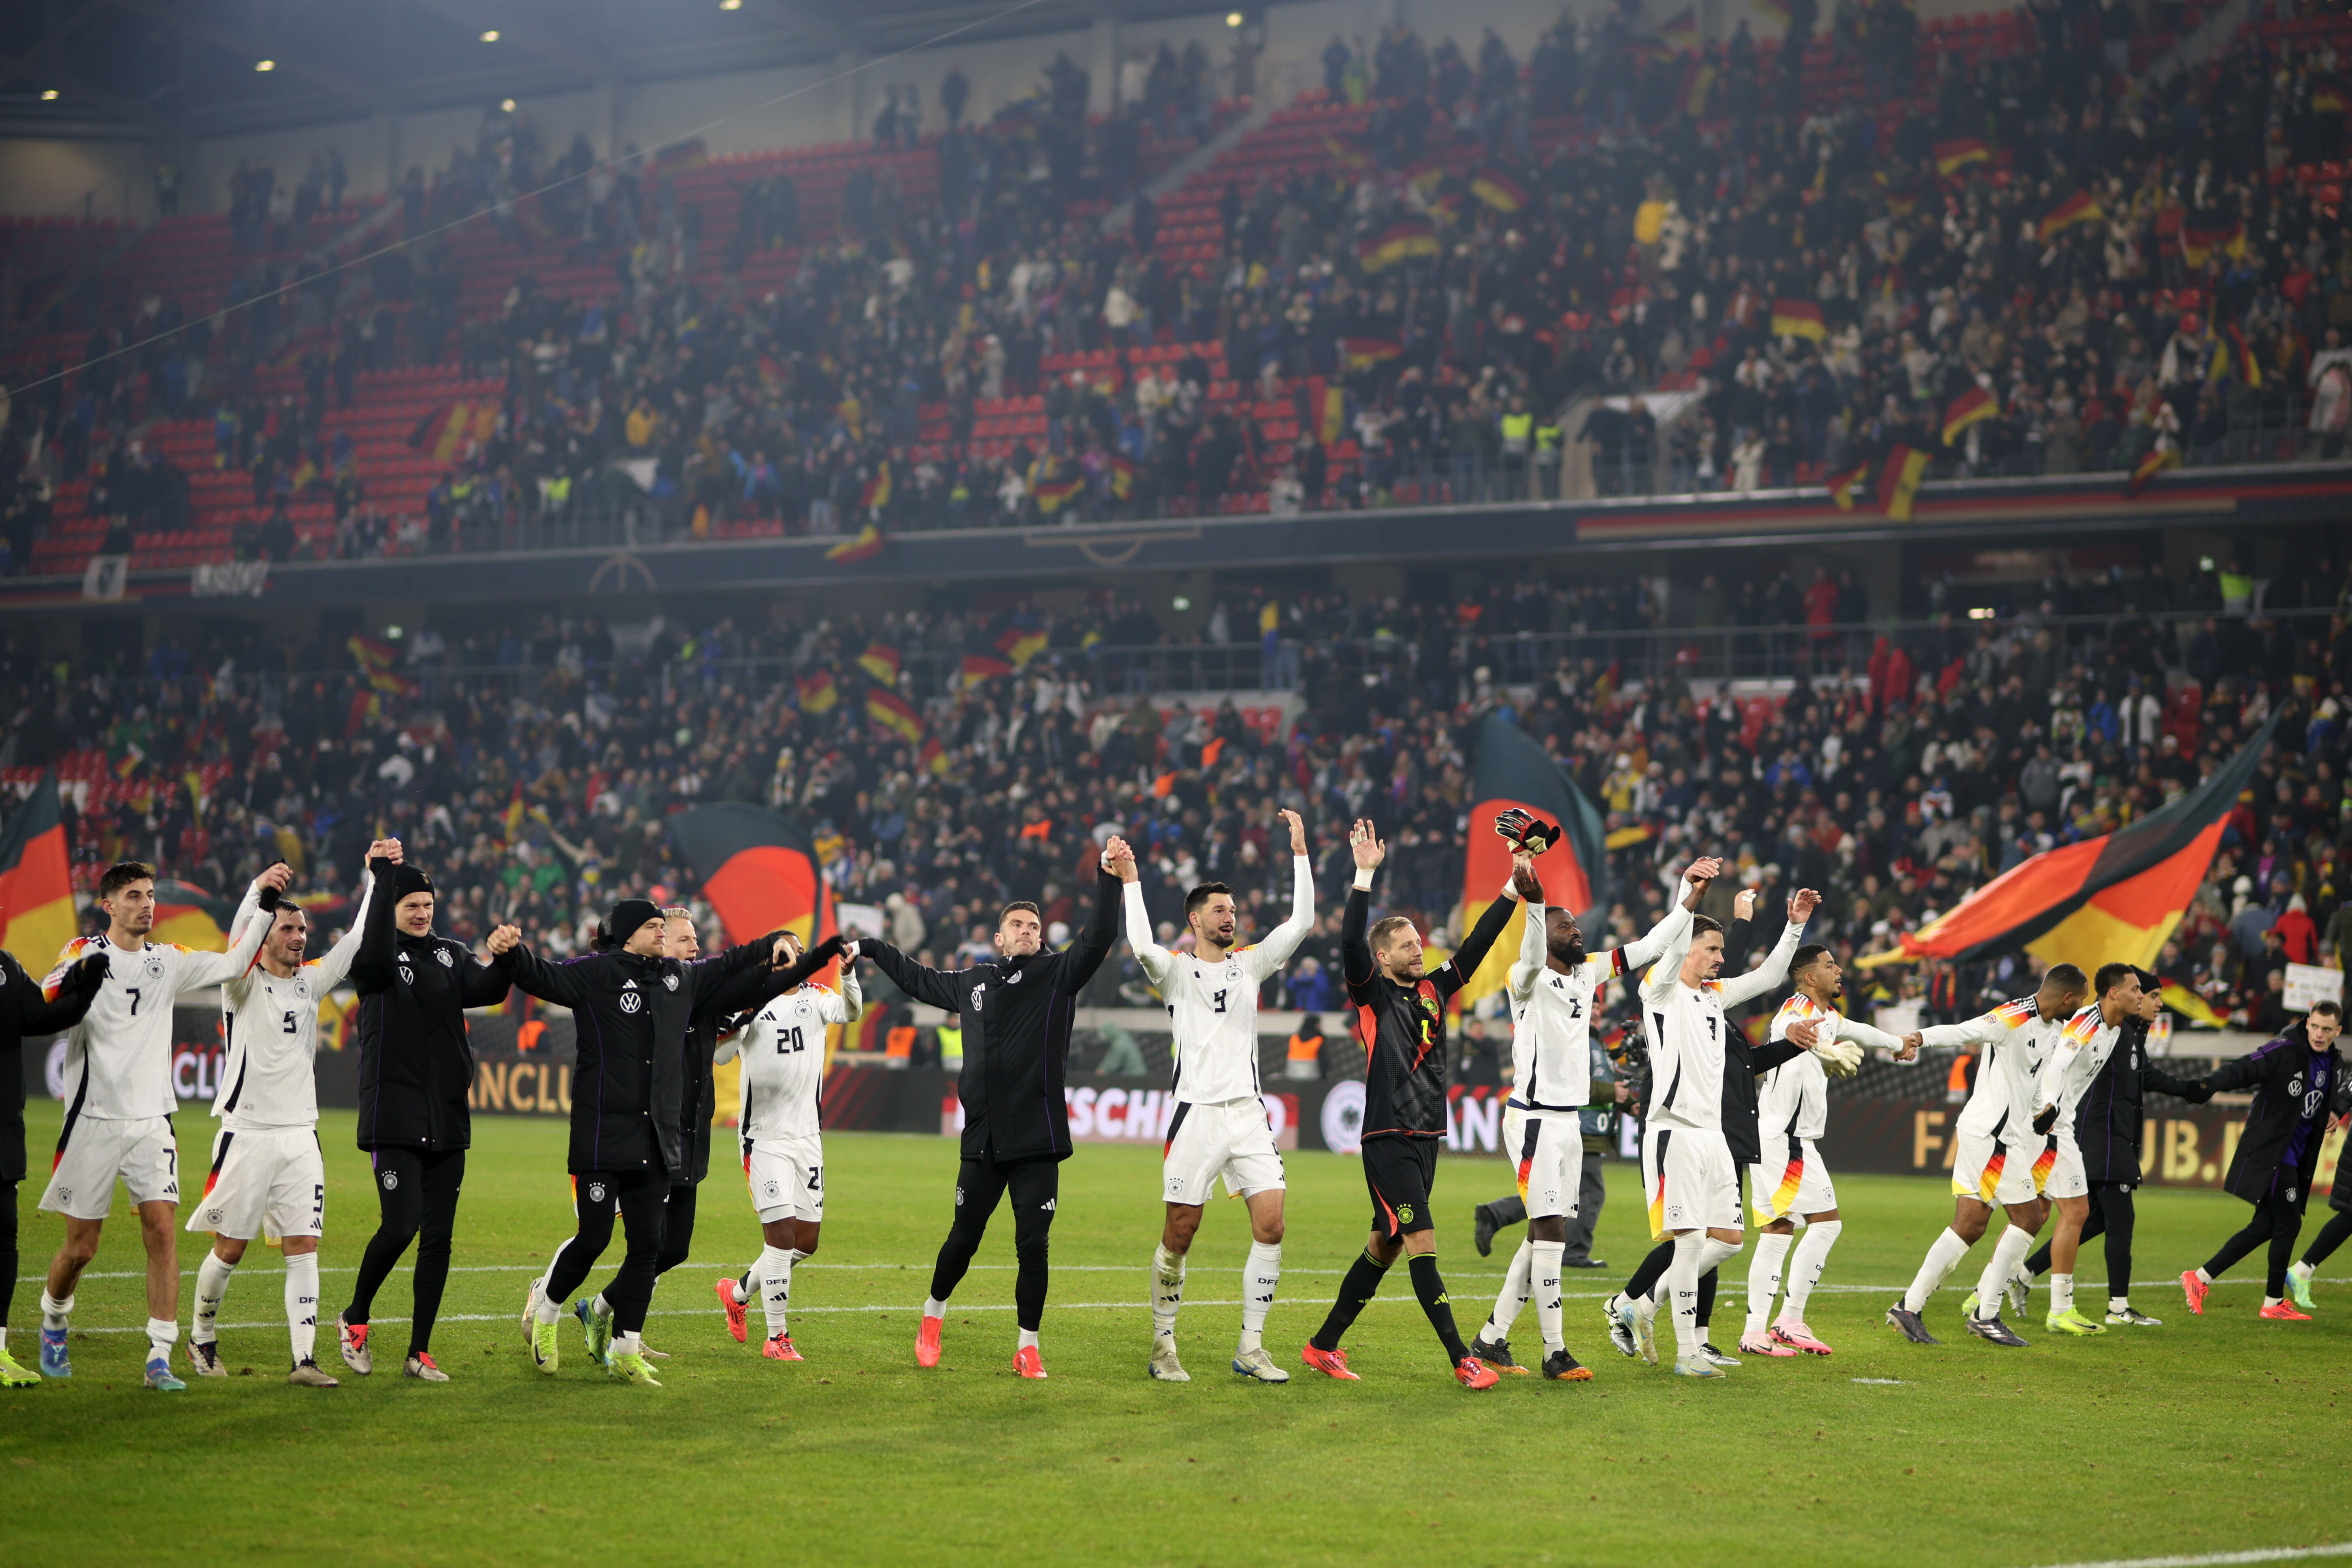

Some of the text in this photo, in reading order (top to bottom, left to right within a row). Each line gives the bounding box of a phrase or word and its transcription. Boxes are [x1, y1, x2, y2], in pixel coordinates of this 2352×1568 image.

[126, 988, 141, 1016] 7
[1214, 989, 1227, 1014] 9
[1569, 999, 1581, 1018] 2
[283, 1011, 296, 1034] 5
[1421, 1020, 1432, 1044] 1
[777, 1026, 805, 1055] 20
[2030, 1058, 2042, 1078] 4
[163, 1148, 175, 1176] 7
[313, 1185, 323, 1214] 5
[1161, 1279, 1184, 1287] DFB
